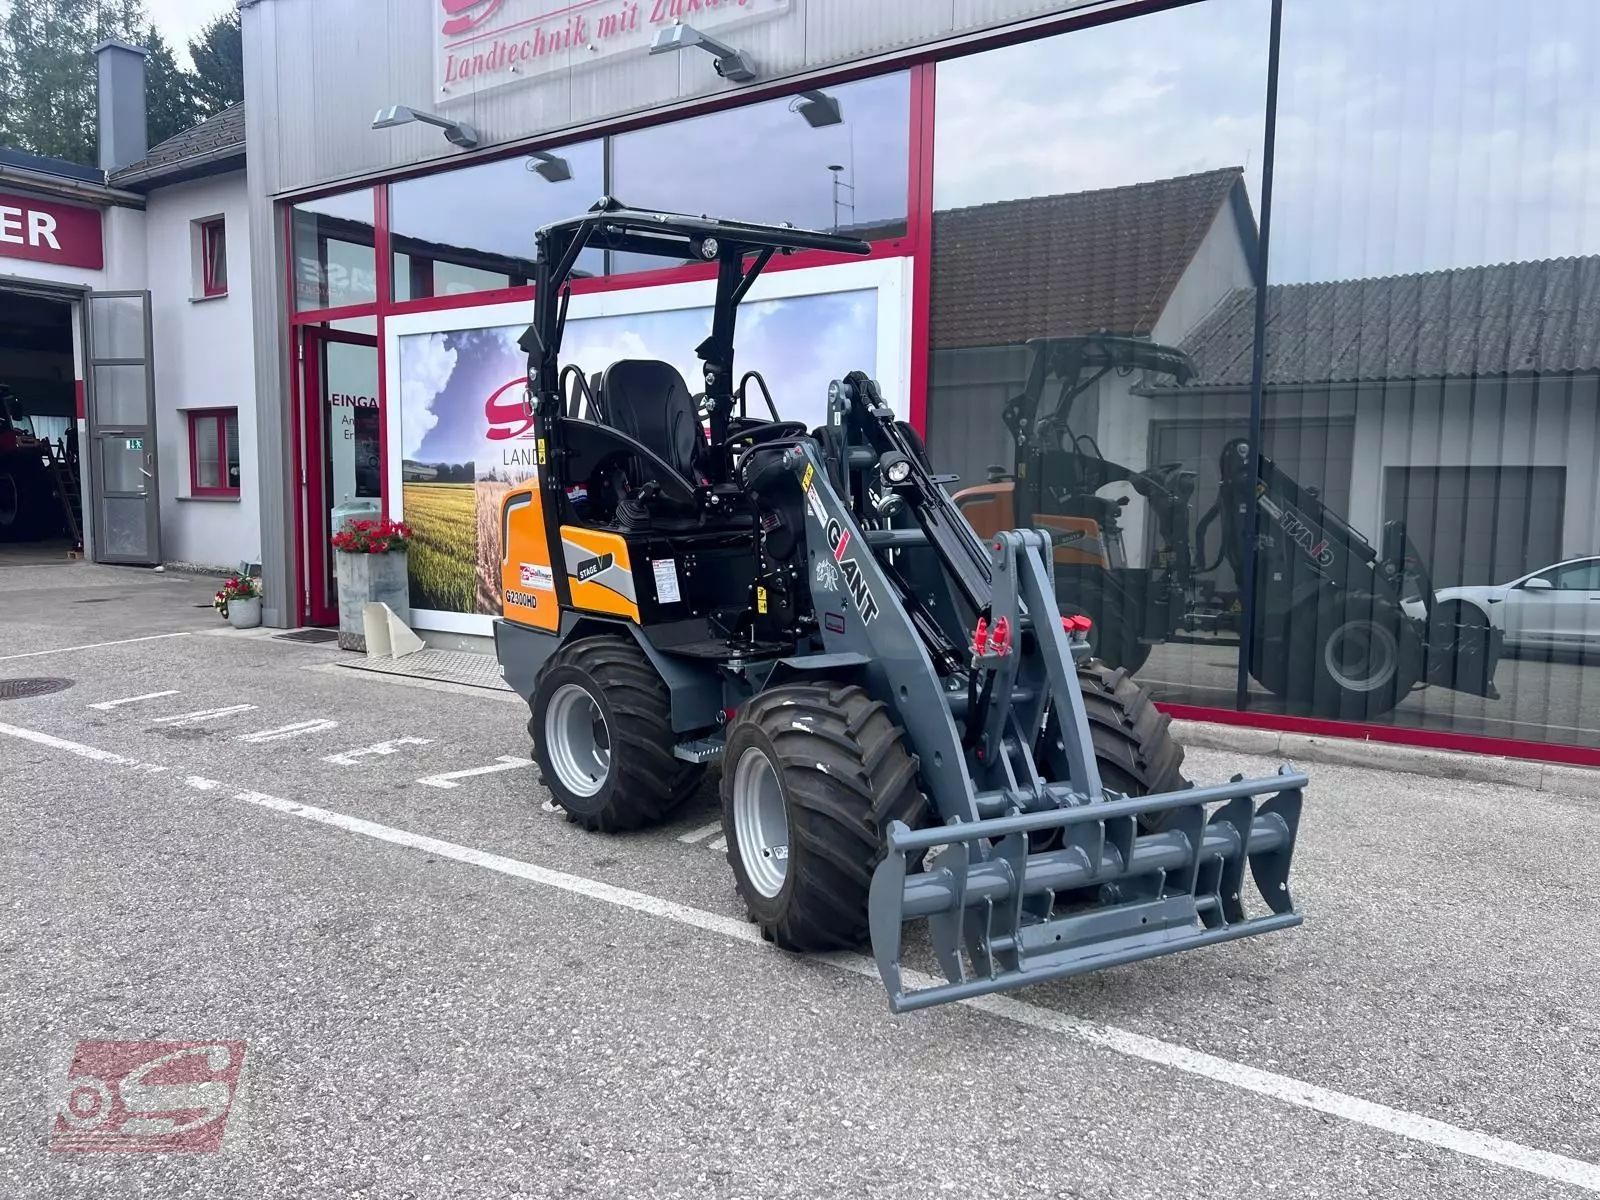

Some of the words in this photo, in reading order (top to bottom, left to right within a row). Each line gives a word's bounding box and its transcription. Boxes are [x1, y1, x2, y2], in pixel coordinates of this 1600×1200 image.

[445, 15, 586, 83] Landtechnik
[597, 1, 639, 39] mit
[0, 205, 62, 250] ER
[331, 393, 379, 409] EINGA
[579, 564, 598, 579] STAGE
[826, 517, 880, 627] GIANT
[505, 589, 537, 609] G2300HD
